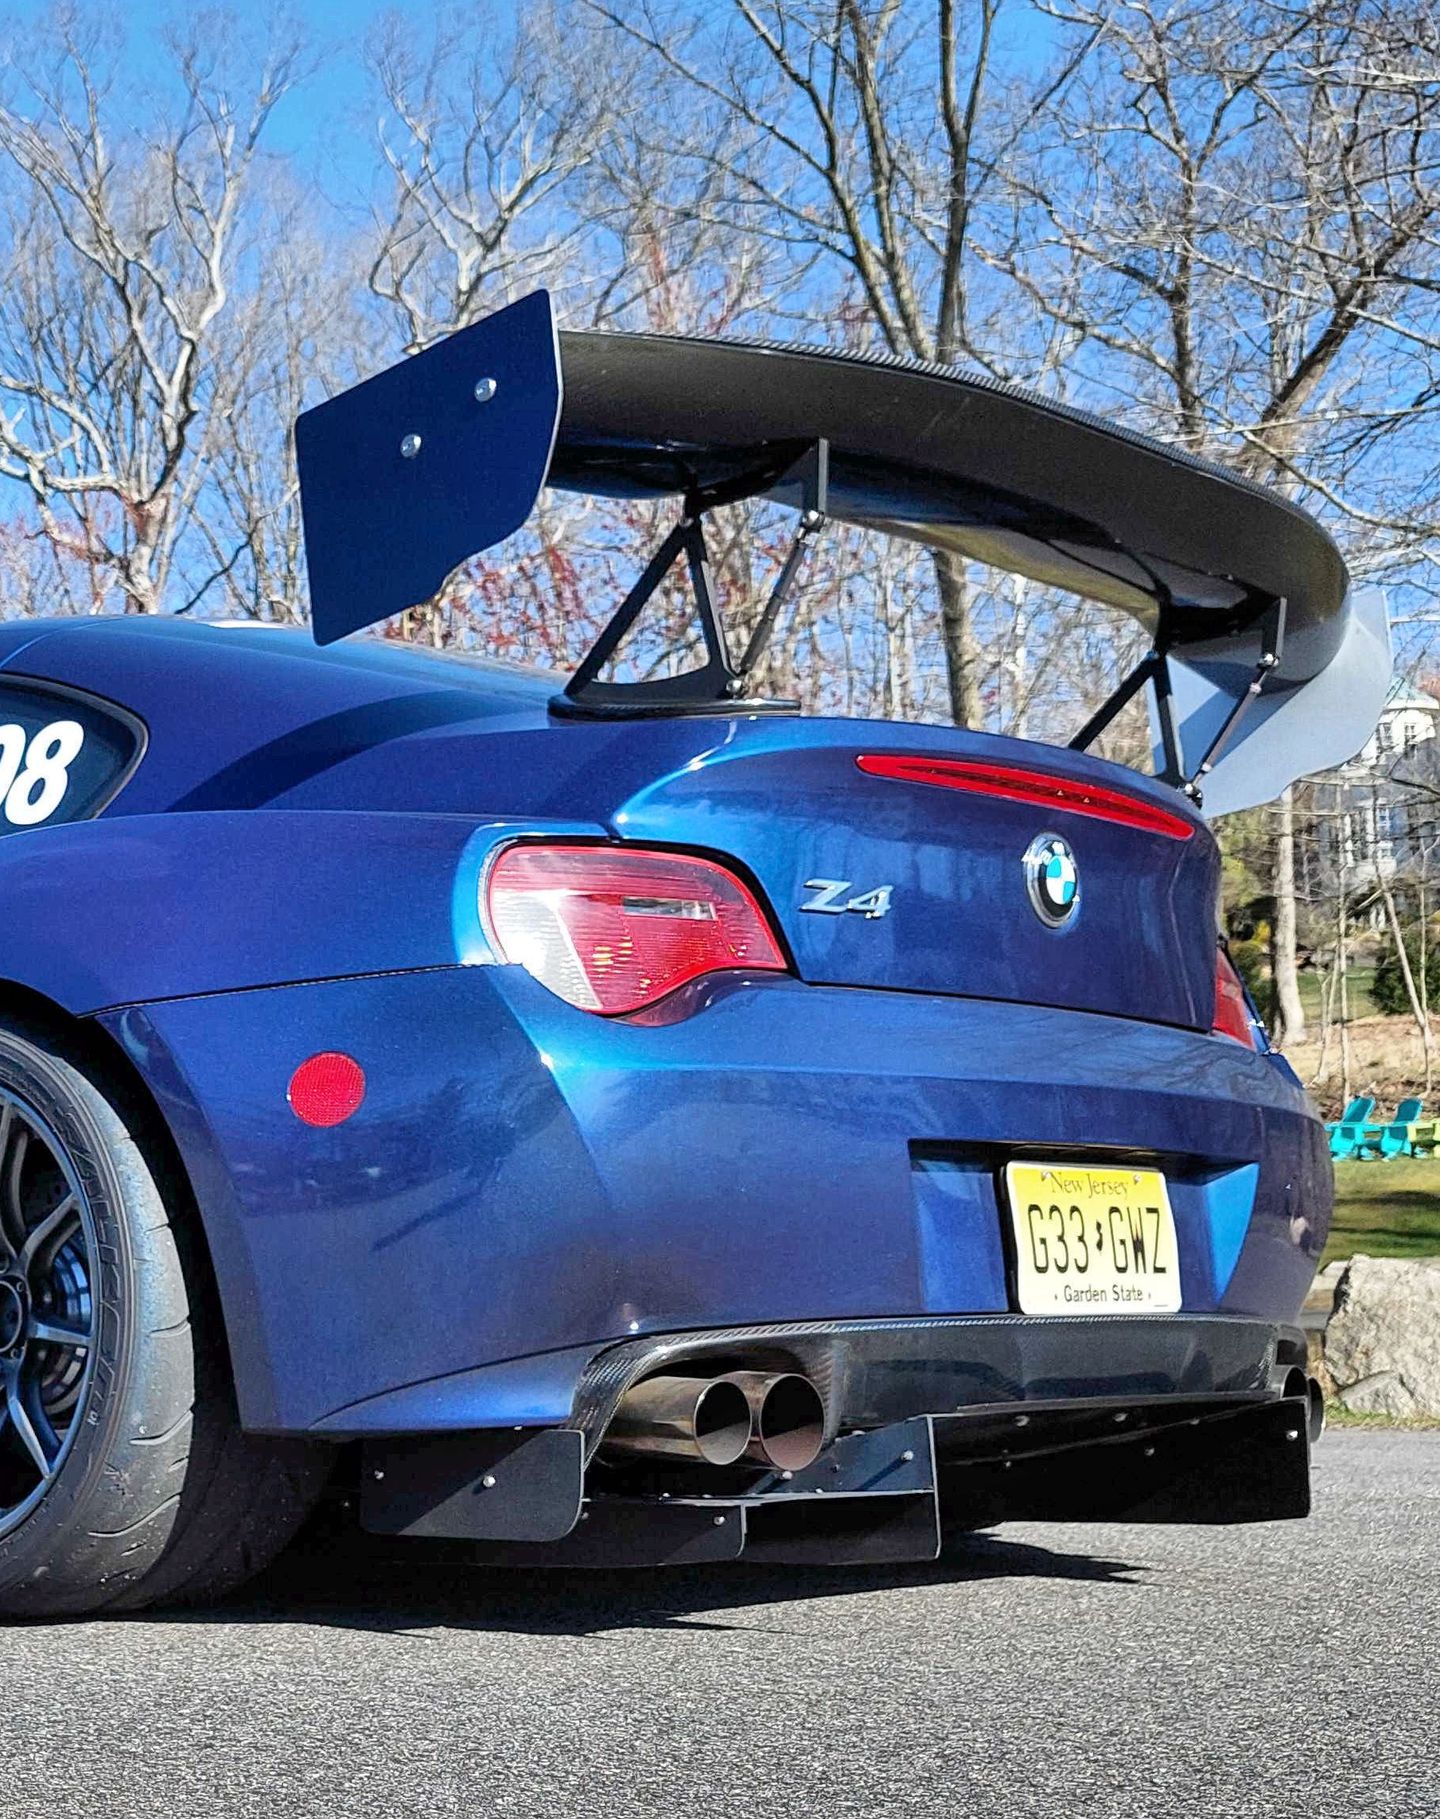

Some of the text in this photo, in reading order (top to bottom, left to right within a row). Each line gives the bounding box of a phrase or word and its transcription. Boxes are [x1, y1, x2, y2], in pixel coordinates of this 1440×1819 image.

[799, 878, 894, 919] Z4
[1049, 1171, 1130, 1198] New Jersey
[1027, 1203, 1167, 1274] G33 GWZ
[1063, 1284, 1144, 1302] Garden State
